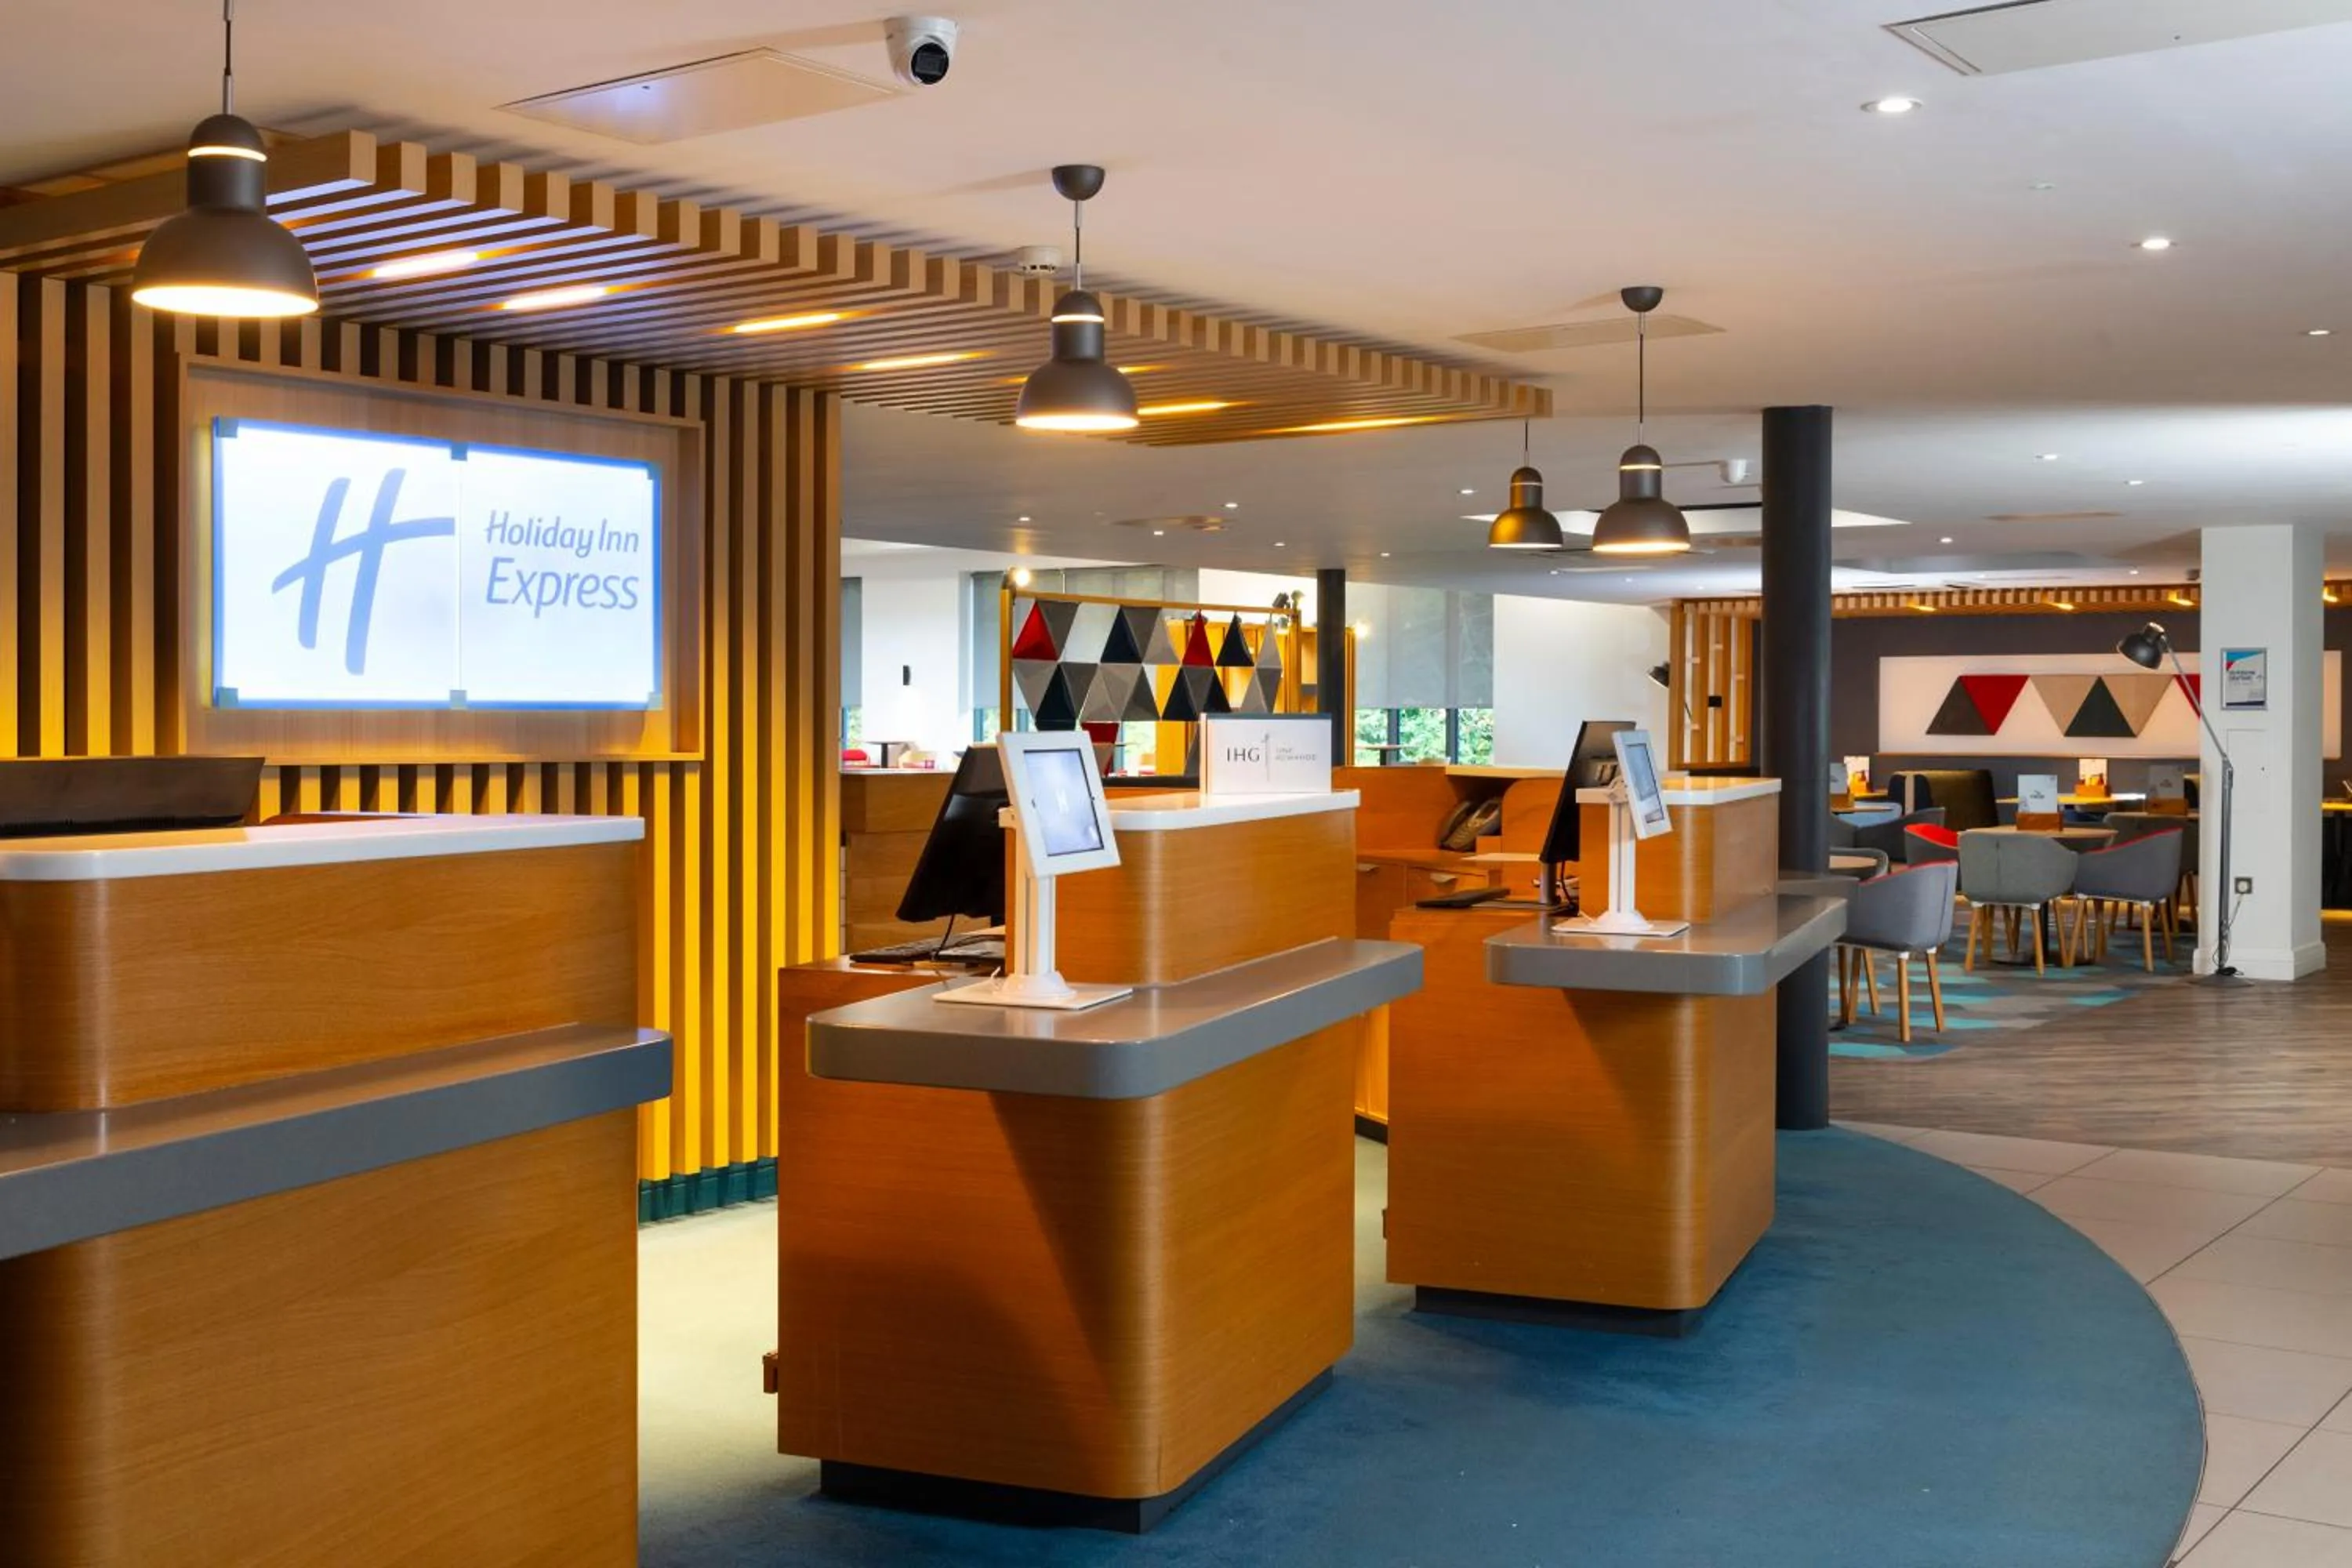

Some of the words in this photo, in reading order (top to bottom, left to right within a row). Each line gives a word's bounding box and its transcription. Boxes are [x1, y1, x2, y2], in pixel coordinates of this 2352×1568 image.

[485, 510, 593, 558] Holiday
[598, 517, 639, 552] Inn
[486, 556, 640, 619] Express
[1227, 746, 1260, 762] IHG
